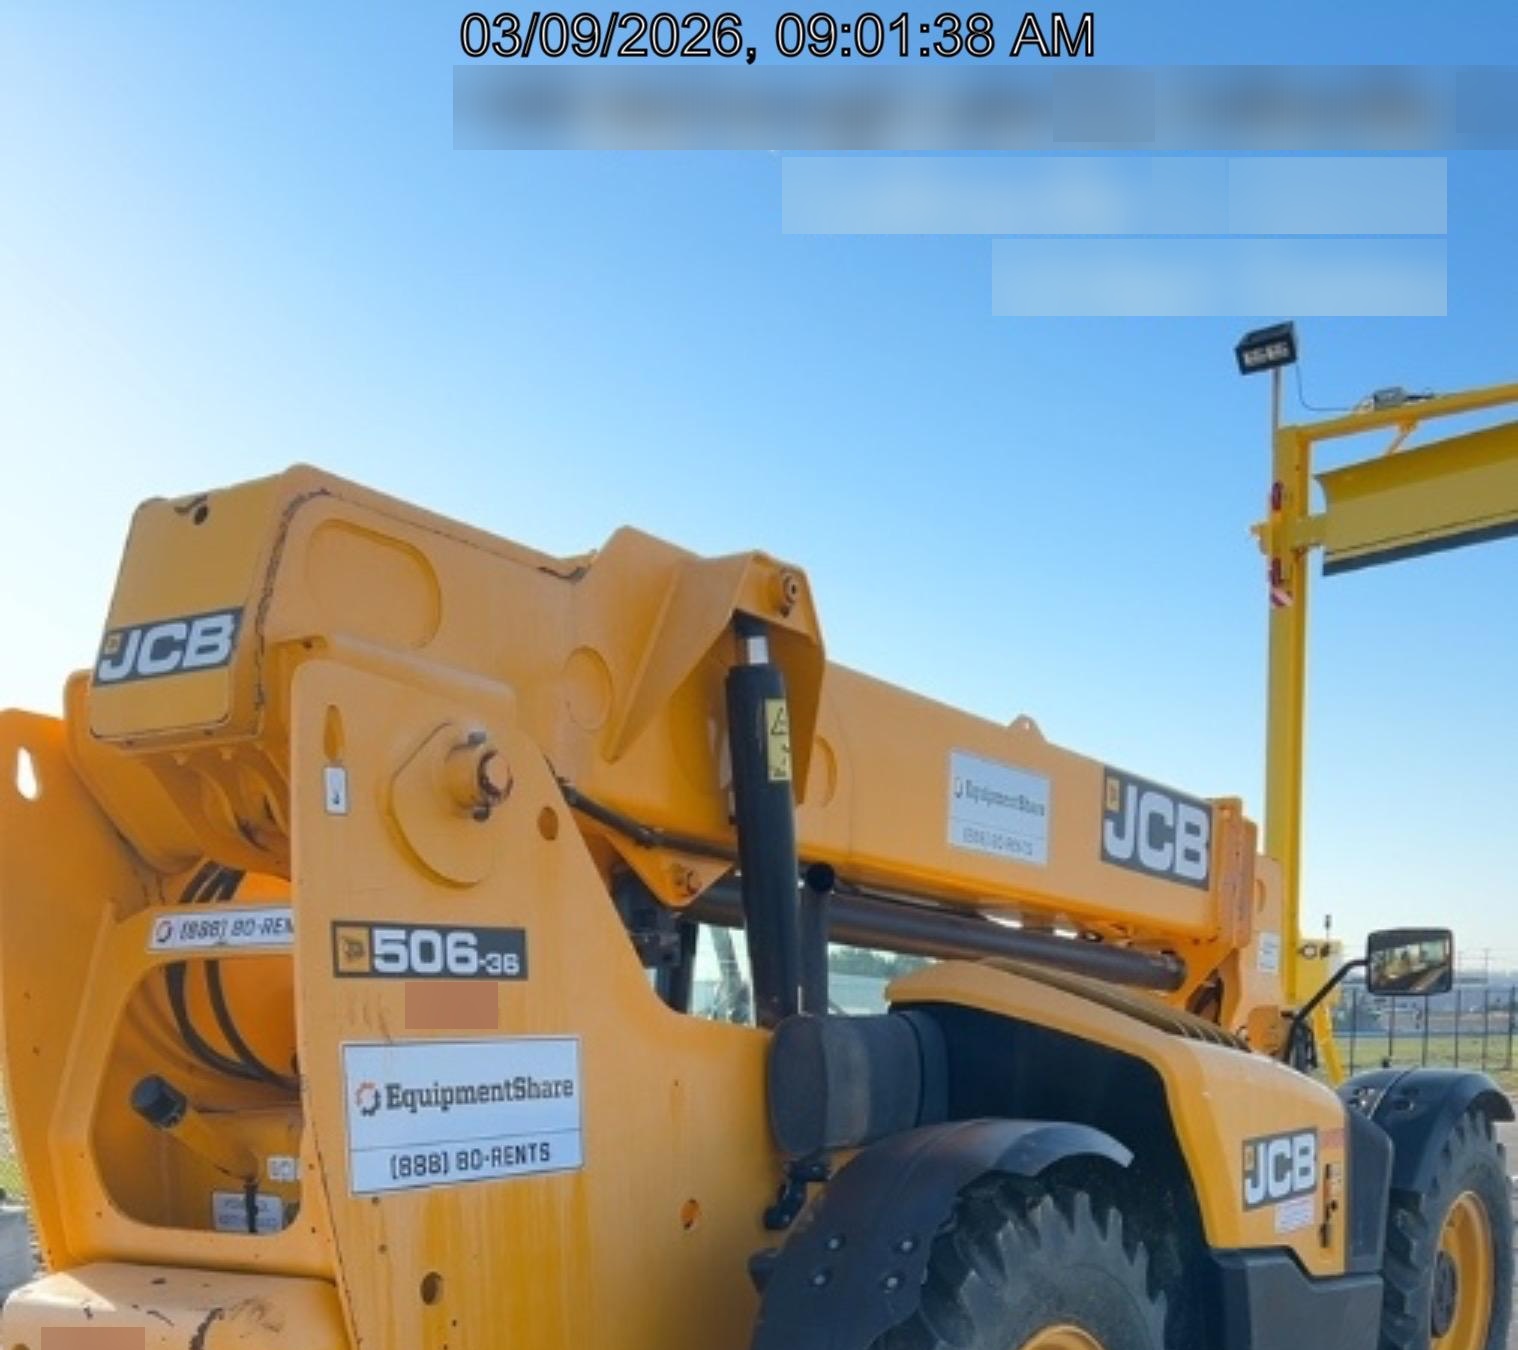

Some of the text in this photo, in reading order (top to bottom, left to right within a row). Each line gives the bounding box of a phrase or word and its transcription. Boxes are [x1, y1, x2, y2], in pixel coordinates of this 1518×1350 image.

[98, 614, 236, 681] JCB
[1103, 784, 1209, 880] JCB
[385, 1075, 574, 1114] EquipmentShare
[455, 1142, 551, 1171] 80-RENTS
[1244, 1133, 1315, 1204] JCB
